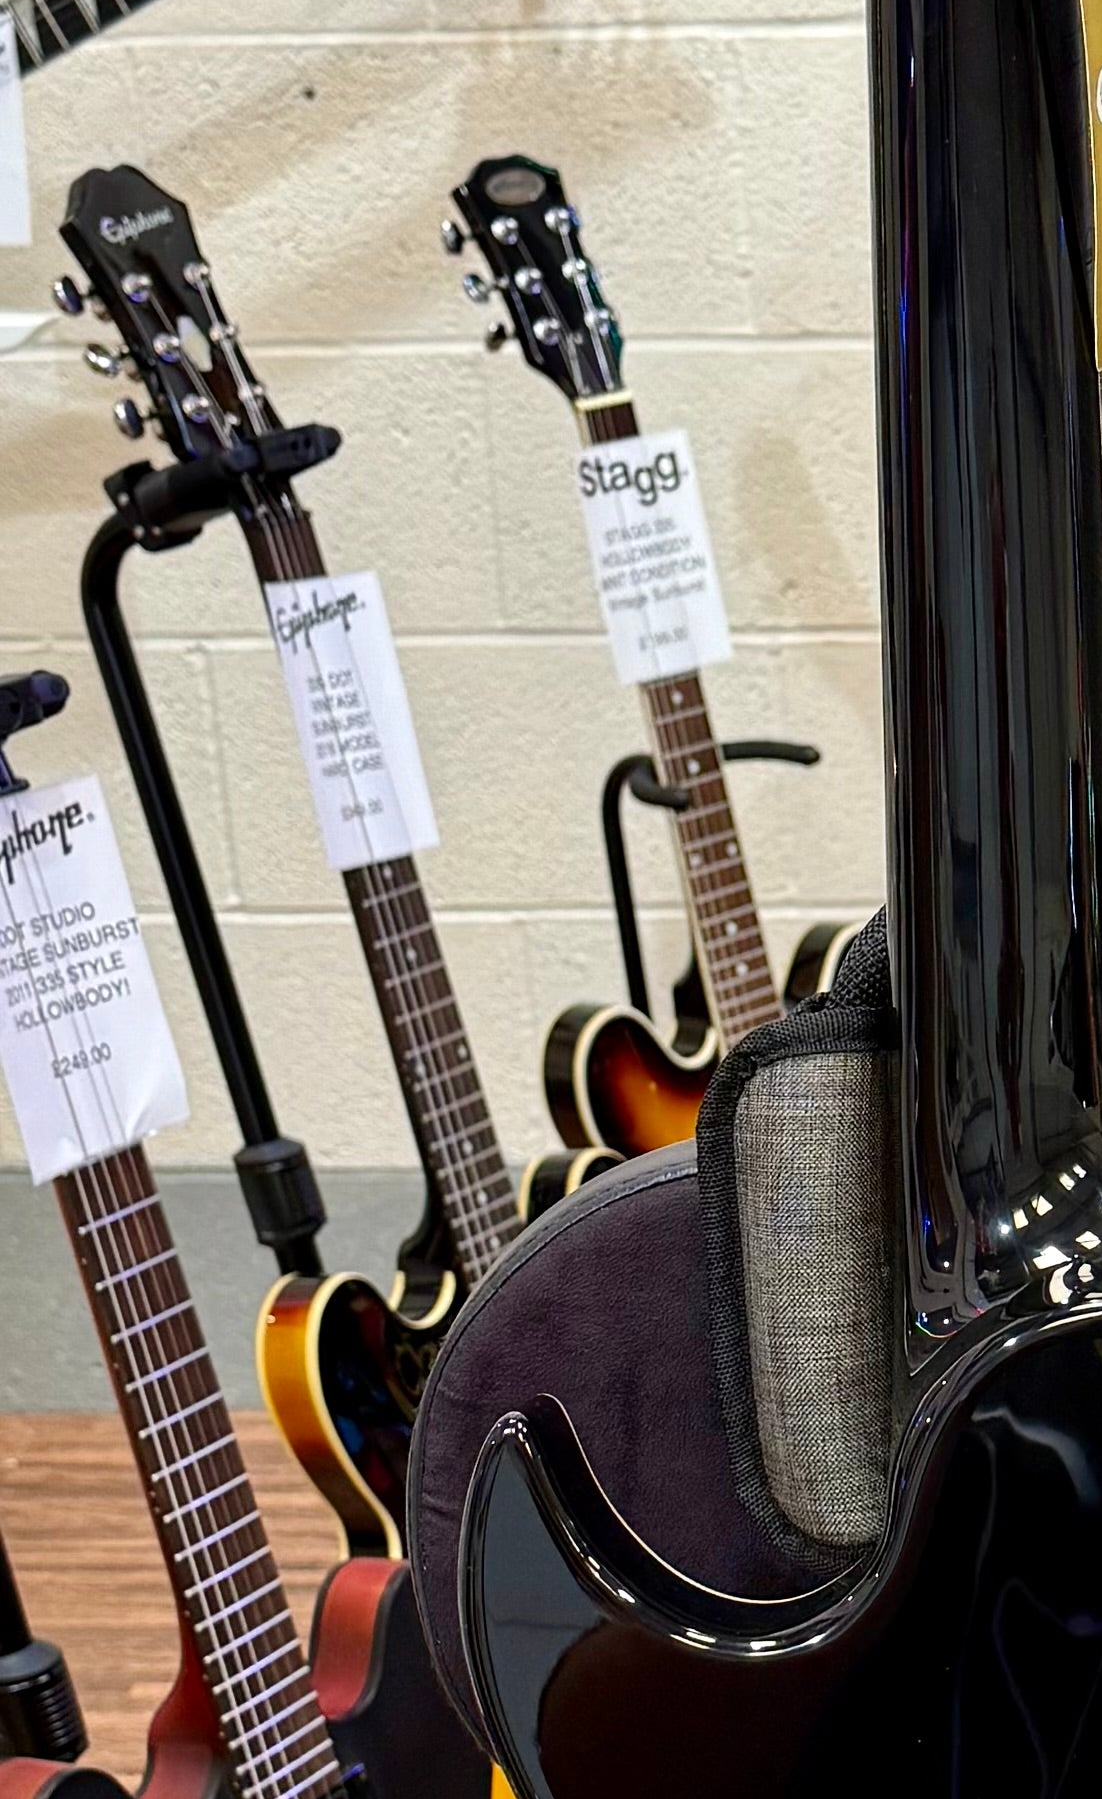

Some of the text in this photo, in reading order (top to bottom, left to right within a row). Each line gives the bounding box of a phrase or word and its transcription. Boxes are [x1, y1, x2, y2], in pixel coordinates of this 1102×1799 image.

[578, 450, 682, 507] Stagg
[30, 901, 96, 937] STUDIO
[43, 917, 140, 963] SUNBURST
[66, 950, 126, 985] STYLE
